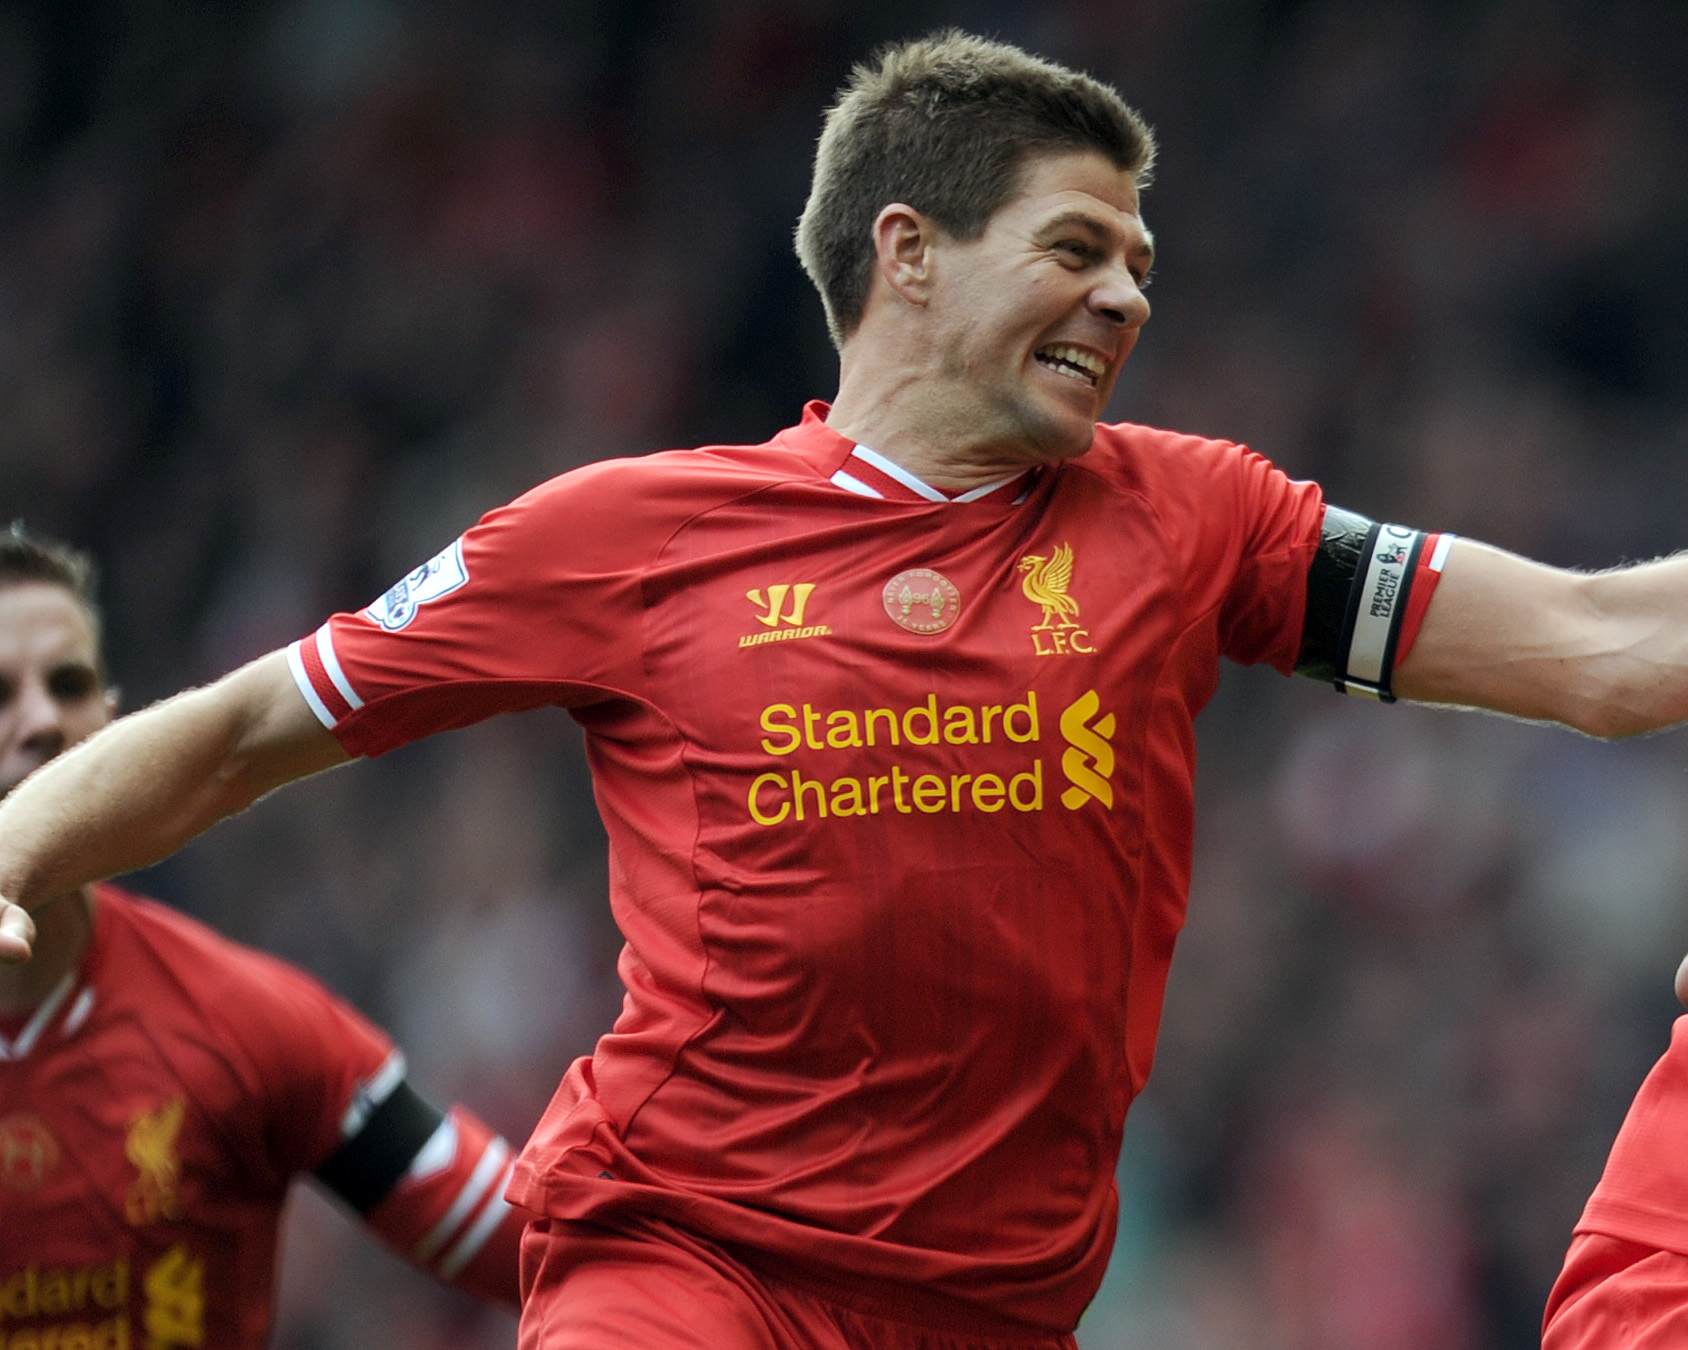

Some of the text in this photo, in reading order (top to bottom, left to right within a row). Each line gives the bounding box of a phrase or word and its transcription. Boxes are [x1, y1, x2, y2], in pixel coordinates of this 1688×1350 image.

[1369, 568, 1391, 617] PREMIER
[1379, 573, 1400, 618] LEAGUE
[739, 625, 829, 648] WARRIOR
[759, 691, 1040, 756] Standard
[747, 759, 1044, 826] Chartered
